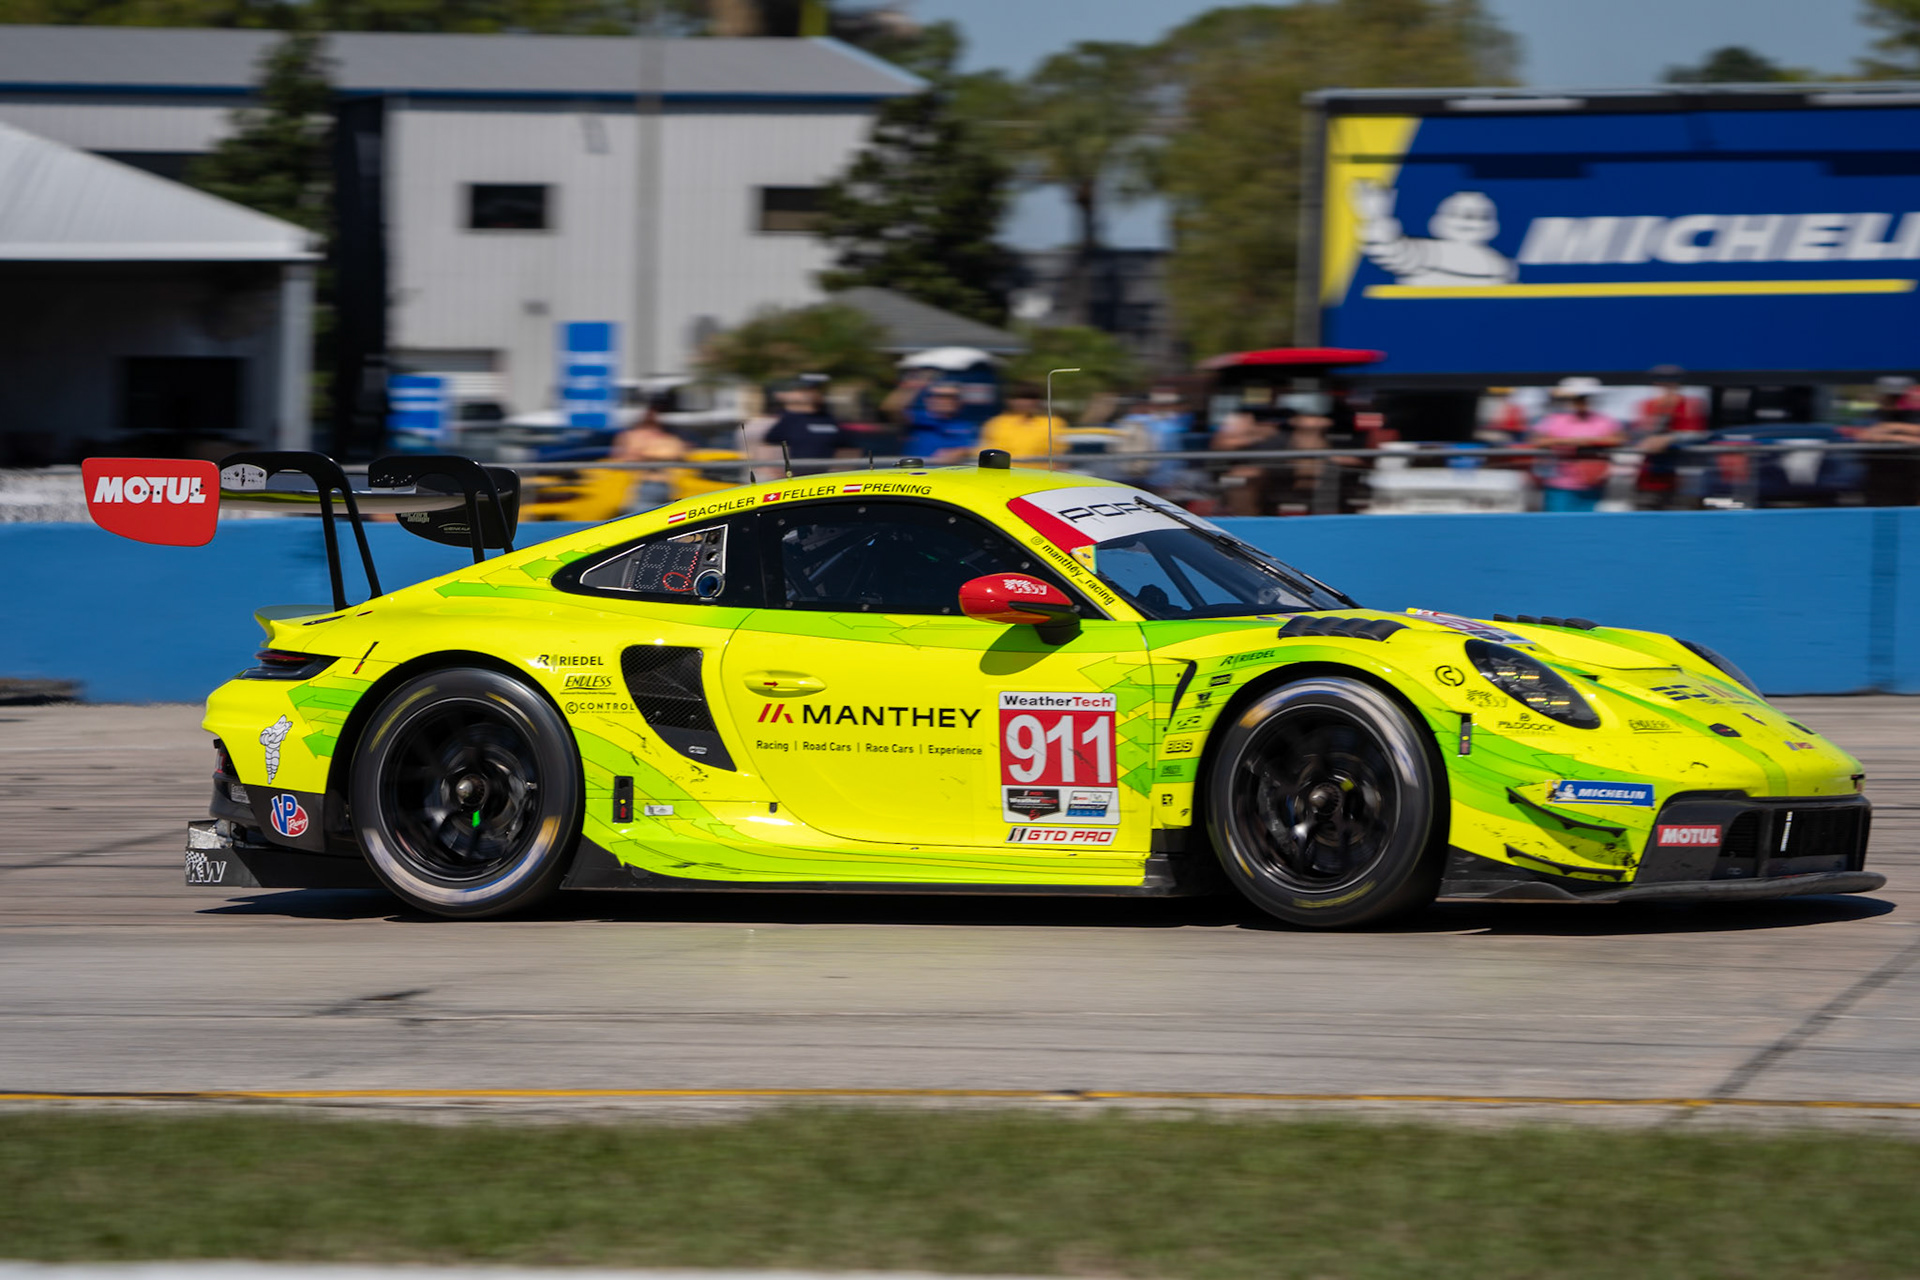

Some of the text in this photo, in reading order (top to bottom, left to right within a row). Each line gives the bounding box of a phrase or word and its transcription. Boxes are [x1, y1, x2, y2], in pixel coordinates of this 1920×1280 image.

[93, 476, 206, 504] MOTUL
[688, 483, 931, 519] BACHLER FELLER PREINING
[1042, 544, 1116, 606] manthey_racing
[559, 656, 604, 666] RIEDEL
[565, 675, 613, 688] ENDLESS
[579, 702, 635, 711] CONTROL
[1003, 695, 1112, 708] WeatherTech
[803, 704, 981, 728] MANTHEY
[756, 740, 983, 756] Racing Road Cars Race Cars Experience
[1005, 714, 1112, 784] 911
[1577, 788, 1648, 800] MICHELIN
[271, 794, 298, 835] VP
[1027, 830, 1113, 843] GTD PRO
[1660, 828, 1719, 844] MOTUL
